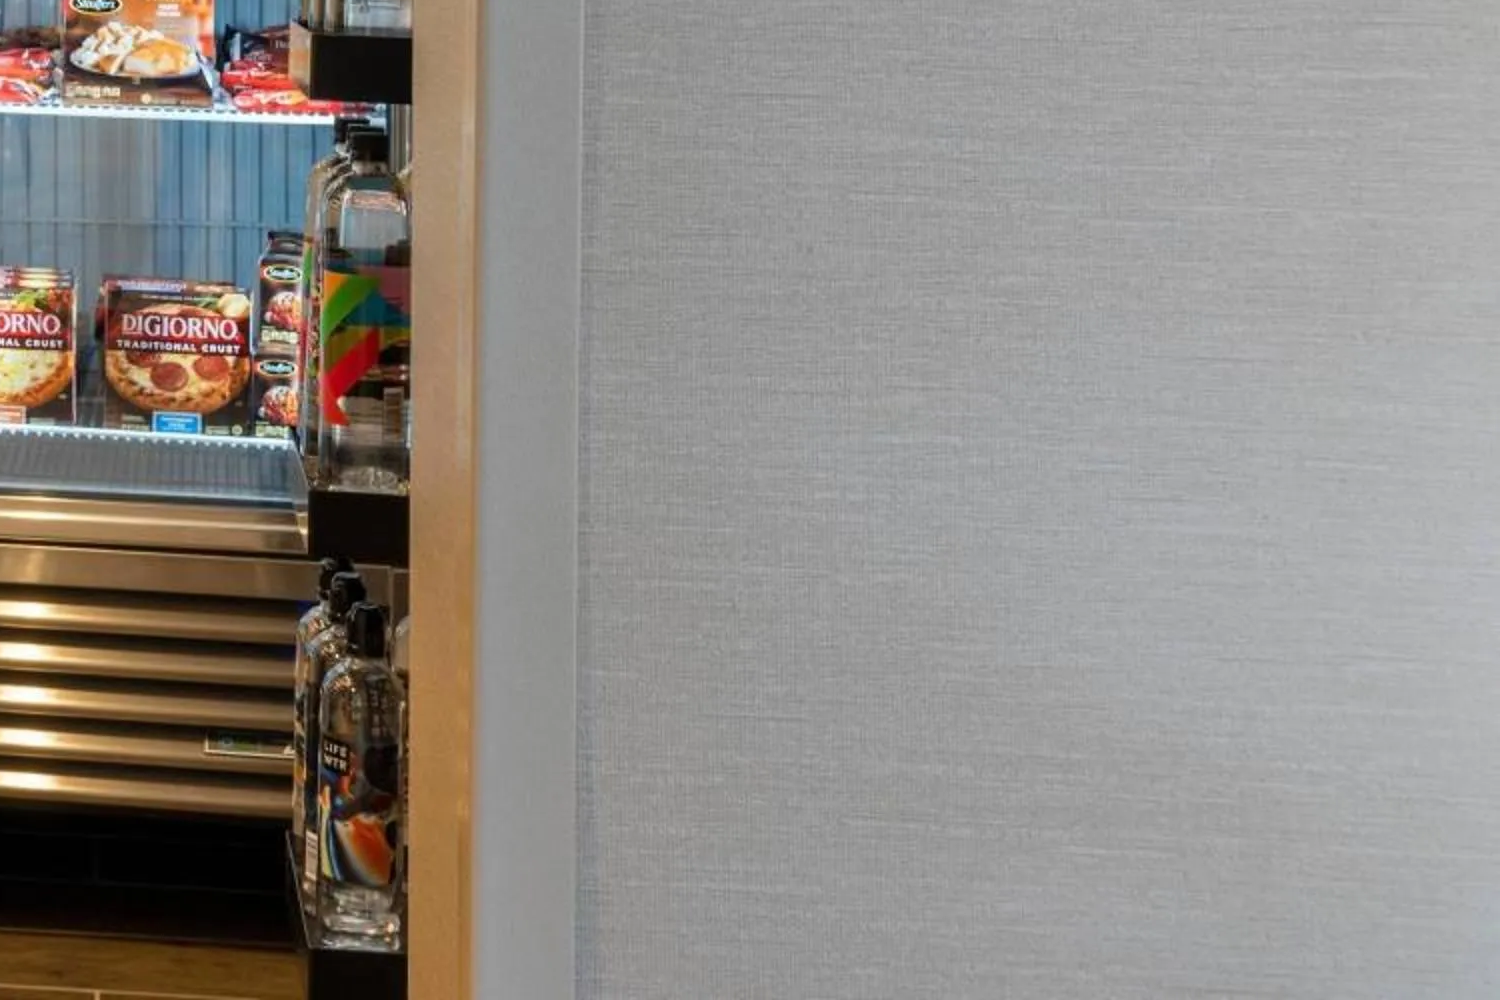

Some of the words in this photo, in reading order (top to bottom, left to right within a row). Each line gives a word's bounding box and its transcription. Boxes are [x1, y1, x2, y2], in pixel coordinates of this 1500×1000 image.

[120, 312, 238, 340] DIGIORNO
[25, 338, 64, 349] CRUST
[116, 338, 197, 353] TRADITIONAL
[201, 343, 241, 355] CRUST
